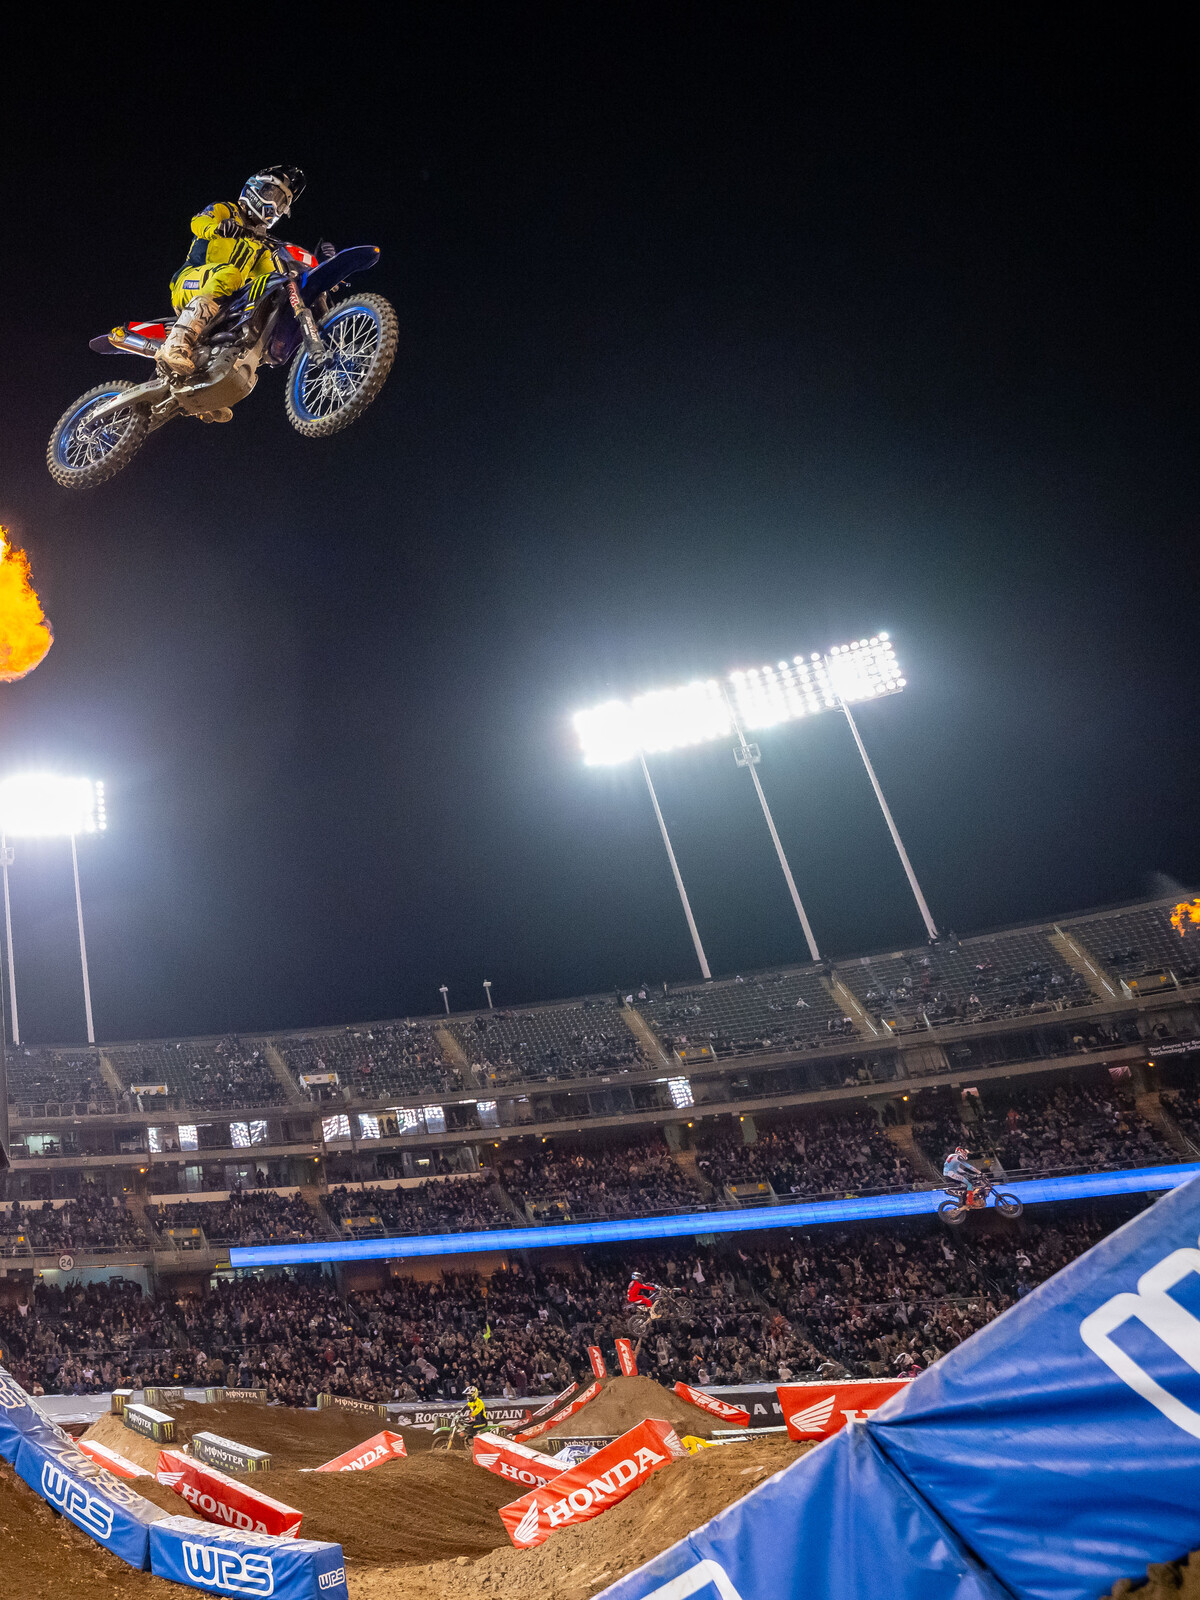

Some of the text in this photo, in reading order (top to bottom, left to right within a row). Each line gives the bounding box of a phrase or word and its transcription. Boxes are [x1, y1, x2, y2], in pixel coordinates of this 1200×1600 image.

[60, 1257, 72, 1268] 24
[334, 1397, 375, 1412] MONSTER
[459, 1408, 524, 1420] MNTAIN
[204, 1444, 245, 1468] MONSTER
[340, 1445, 389, 1472] ONDA
[500, 1461, 549, 1488] HON
[543, 1446, 666, 1528] HONDA
[41, 1460, 114, 1539] WPS
[181, 1482, 270, 1535] HONDA
[181, 1540, 275, 1598] WPS
[318, 1566, 346, 1591] WPS
